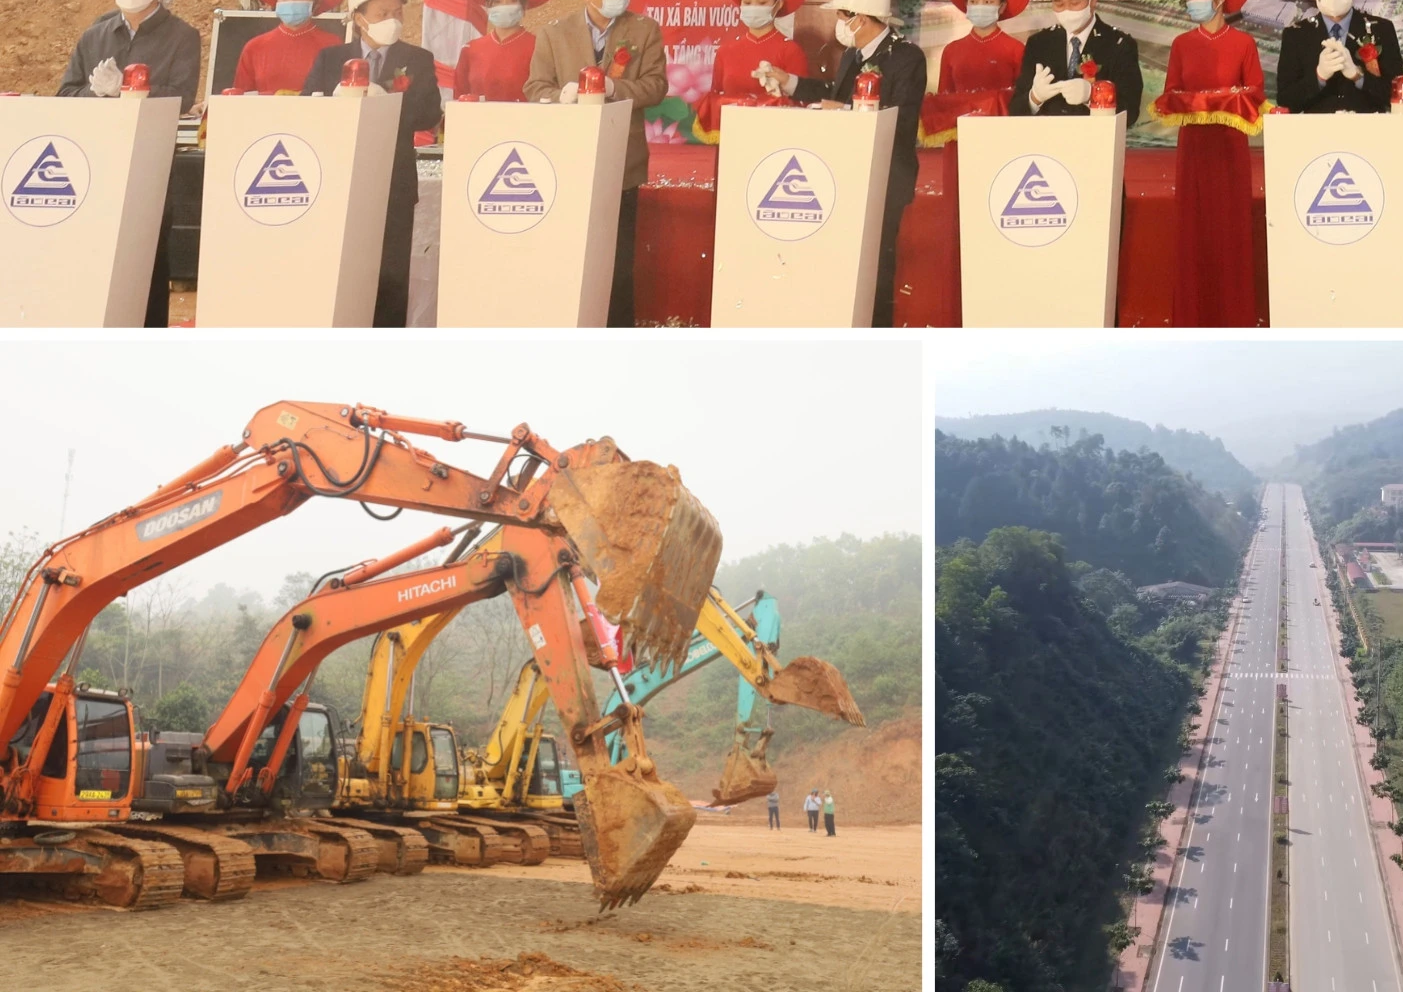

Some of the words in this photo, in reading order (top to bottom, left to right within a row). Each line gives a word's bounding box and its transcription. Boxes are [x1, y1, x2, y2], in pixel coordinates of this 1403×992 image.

[666, 2, 681, 27] XÃ
[683, 1, 706, 27] BẢN
[709, 4, 740, 32] VƯỢC
[143, 493, 217, 539] DOOSAN
[397, 575, 457, 603] HITACHI
